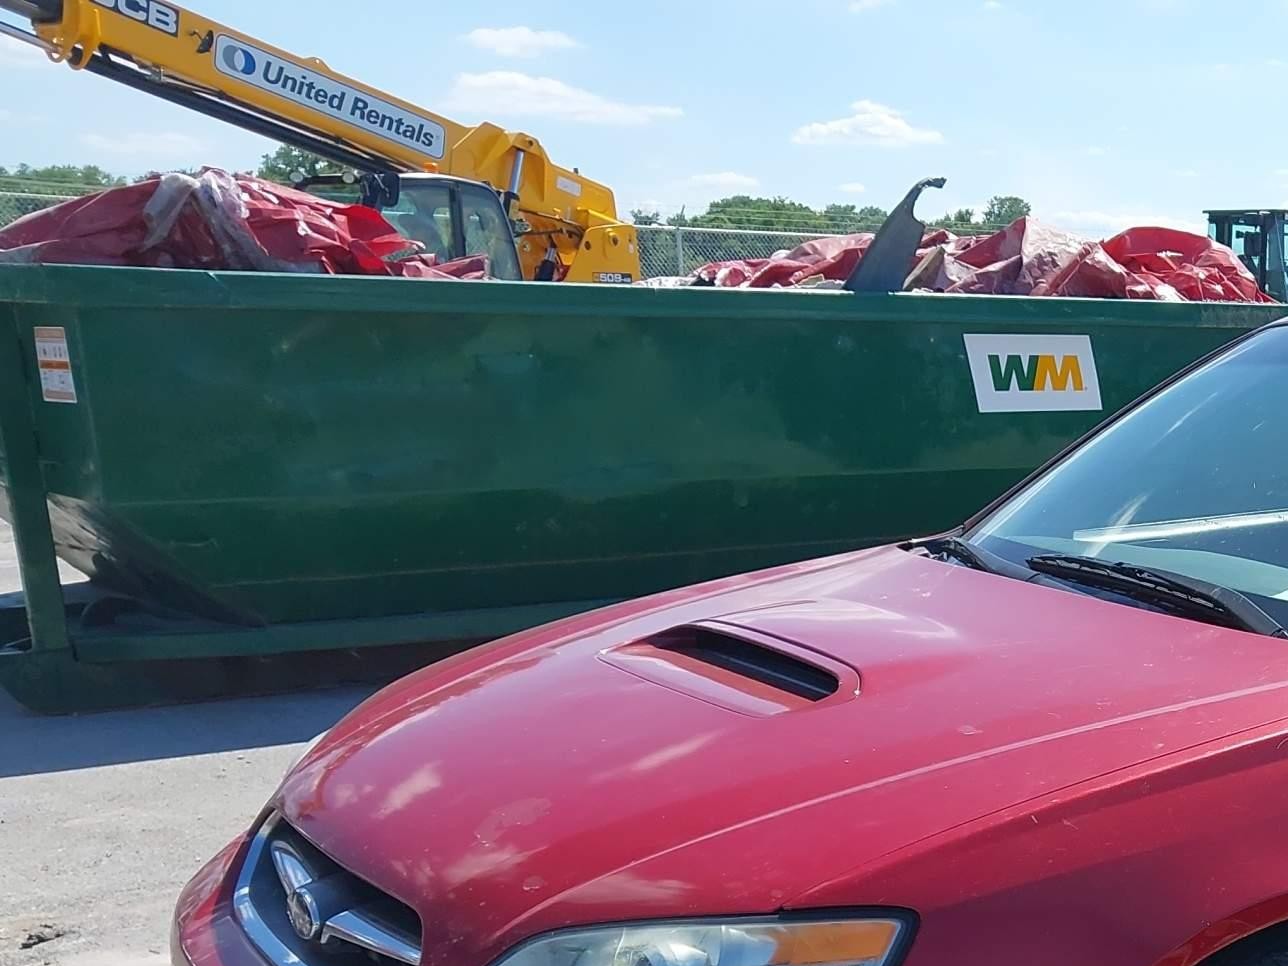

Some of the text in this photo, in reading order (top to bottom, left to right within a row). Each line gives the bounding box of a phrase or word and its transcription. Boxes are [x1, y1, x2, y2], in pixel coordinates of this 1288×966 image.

[93, 0, 177, 34] CB
[262, 60, 435, 148] United Rentals
[987, 354, 1084, 392] WM
